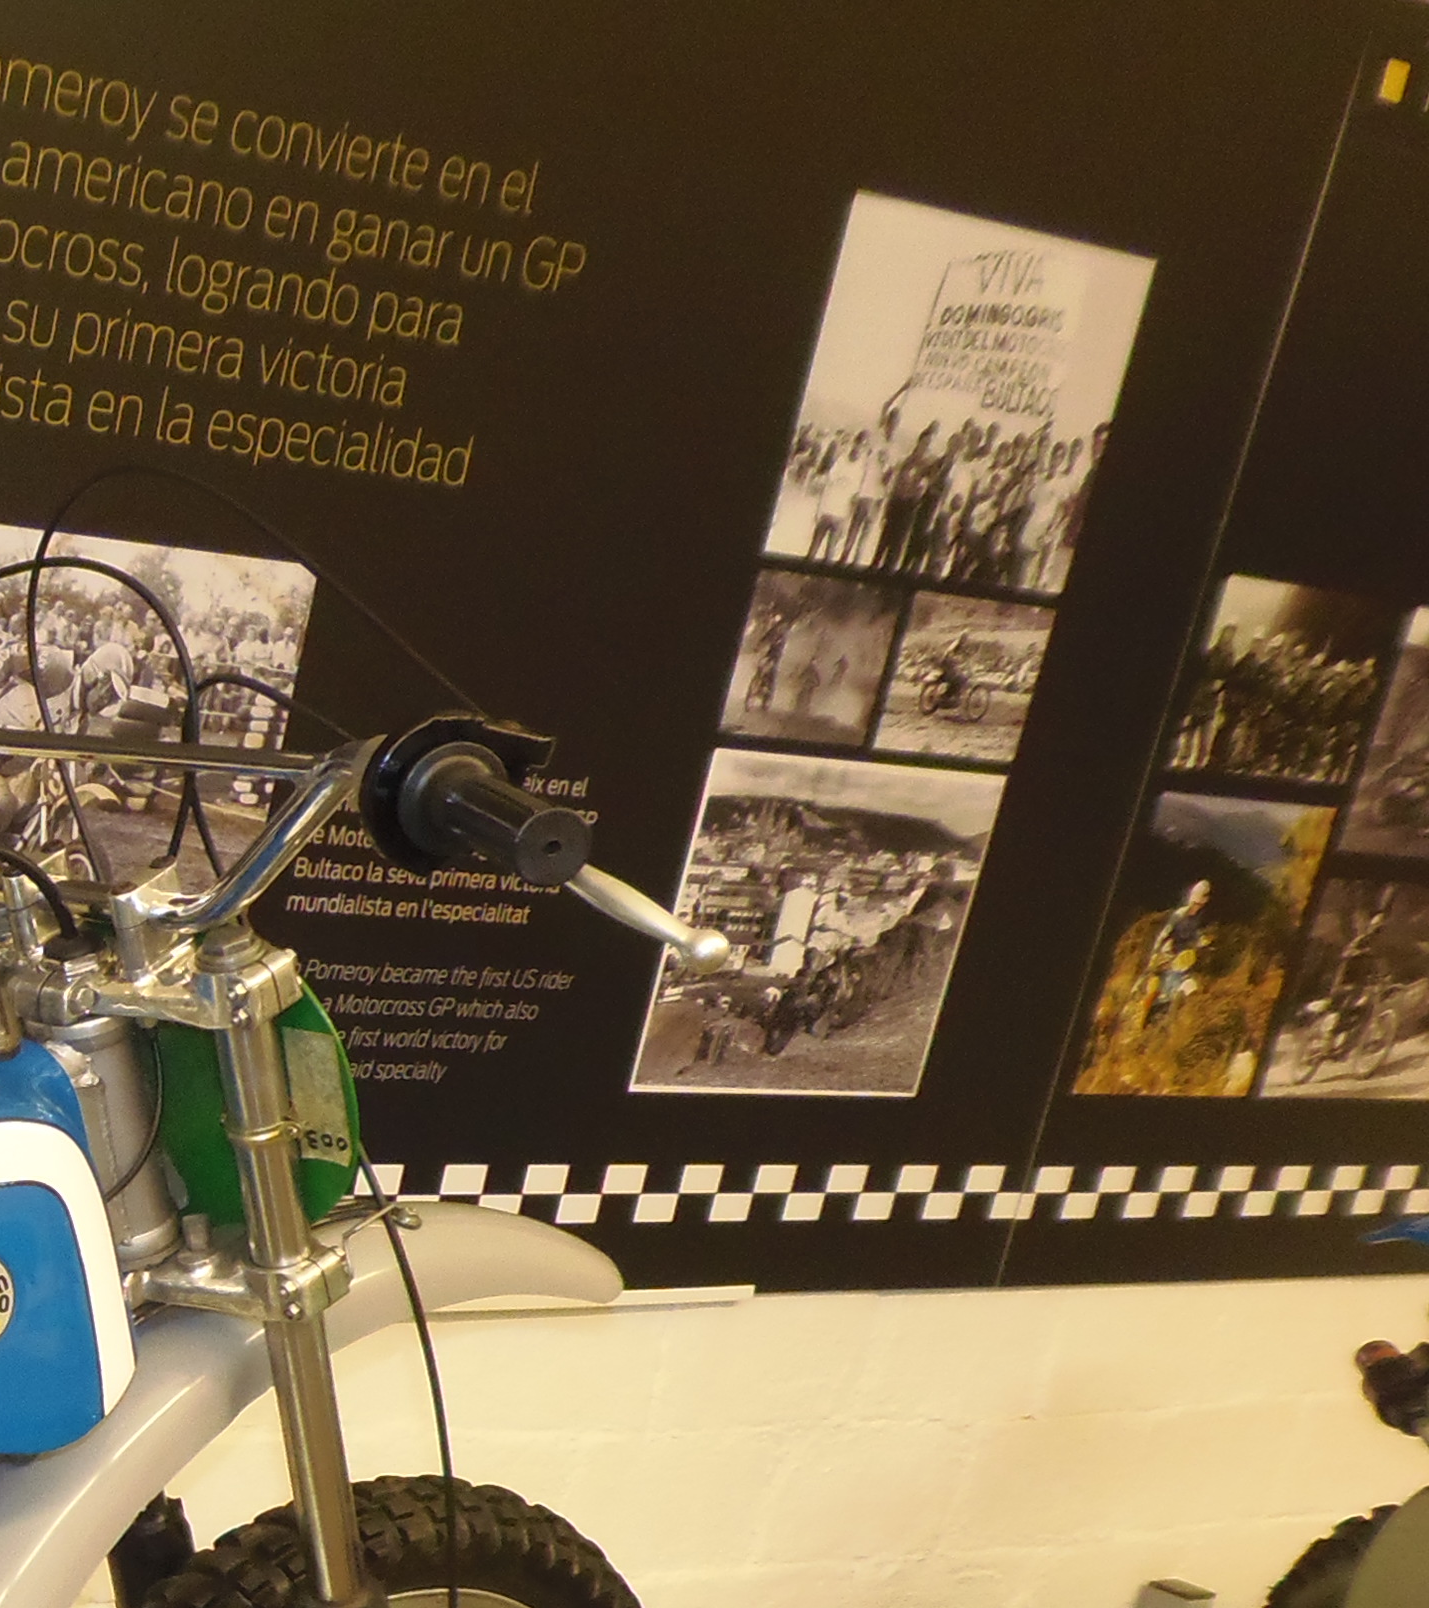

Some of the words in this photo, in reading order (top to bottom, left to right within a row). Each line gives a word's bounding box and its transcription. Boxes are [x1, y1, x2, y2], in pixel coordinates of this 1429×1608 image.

[166, 93, 219, 146] se
[230, 107, 430, 193] convierte
[440, 151, 490, 206] en
[500, 160, 539, 215] el
[1, 134, 253, 234] americano
[265, 193, 319, 244] en
[326, 205, 453, 270] ganar
[461, 228, 512, 284] un
[523, 235, 586, 295] GP
[165, 238, 360, 327] logrando
[367, 288, 465, 346] para
[3, 295, 57, 350] su
[70, 309, 244, 381] primera
[260, 336, 407, 409] victoria
[86, 389, 145, 437] en
[154, 387, 195, 447] la
[207, 408, 474, 489] especialidad
[548, 778, 569, 796] en
[572, 776, 589, 798] el
[294, 857, 364, 882] Bultaco
[366, 862, 382, 883] la
[429, 867, 496, 890] primera
[286, 893, 392, 917] mundialista
[395, 901, 419, 918] en
[421, 899, 531, 925] l'especialitat
[304, 959, 381, 985] Pomeroy
[381, 962, 448, 985] became
[451, 966, 476, 986] the
[478, 966, 511, 989] first
[512, 968, 539, 988] US
[539, 970, 575, 990] rider
[335, 994, 425, 1016] Motorcross
[428, 997, 455, 1017] GP
[456, 998, 502, 1018] which
[504, 1001, 539, 1020] also
[347, 1026, 378, 1049] first
[383, 1028, 429, 1048] world
[432, 1029, 483, 1053] victory
[483, 1030, 508, 1051] for
[351, 1060, 374, 1078] aid
[374, 1061, 447, 1083] specialty
